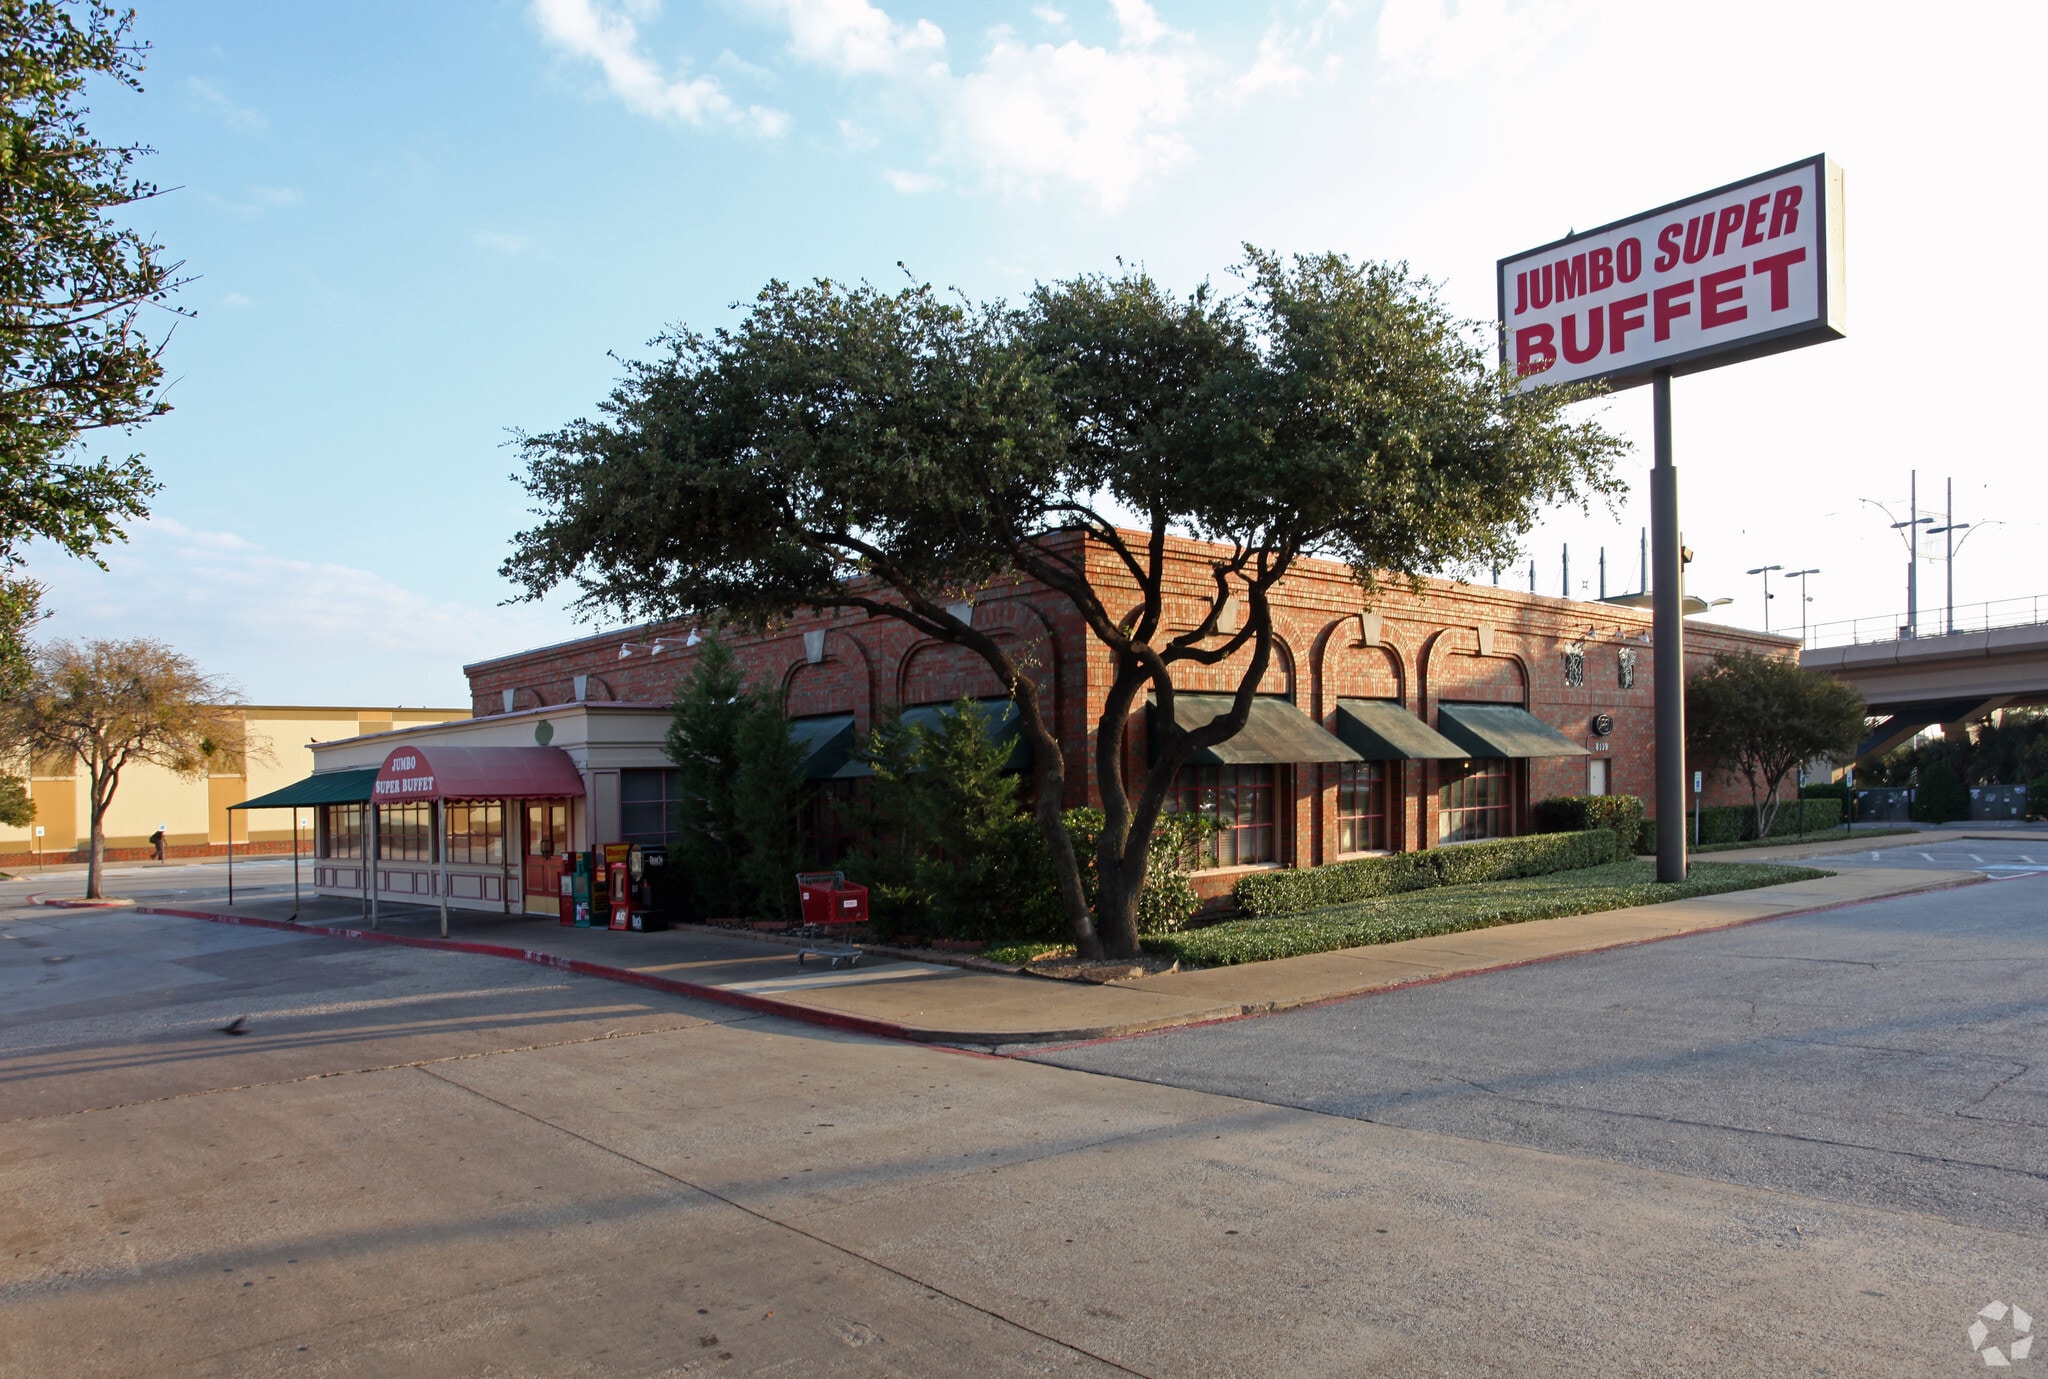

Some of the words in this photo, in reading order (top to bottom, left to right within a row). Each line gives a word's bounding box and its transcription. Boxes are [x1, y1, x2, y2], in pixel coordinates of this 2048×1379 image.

[1515, 238, 1641, 315] JUMBO
[1655, 186, 1802, 273] SUPER
[1516, 247, 1806, 376] BUFFET
[376, 780, 400, 794] SUPER
[402, 776, 434, 792] BUFFET
[392, 756, 416, 771] JUMBO
